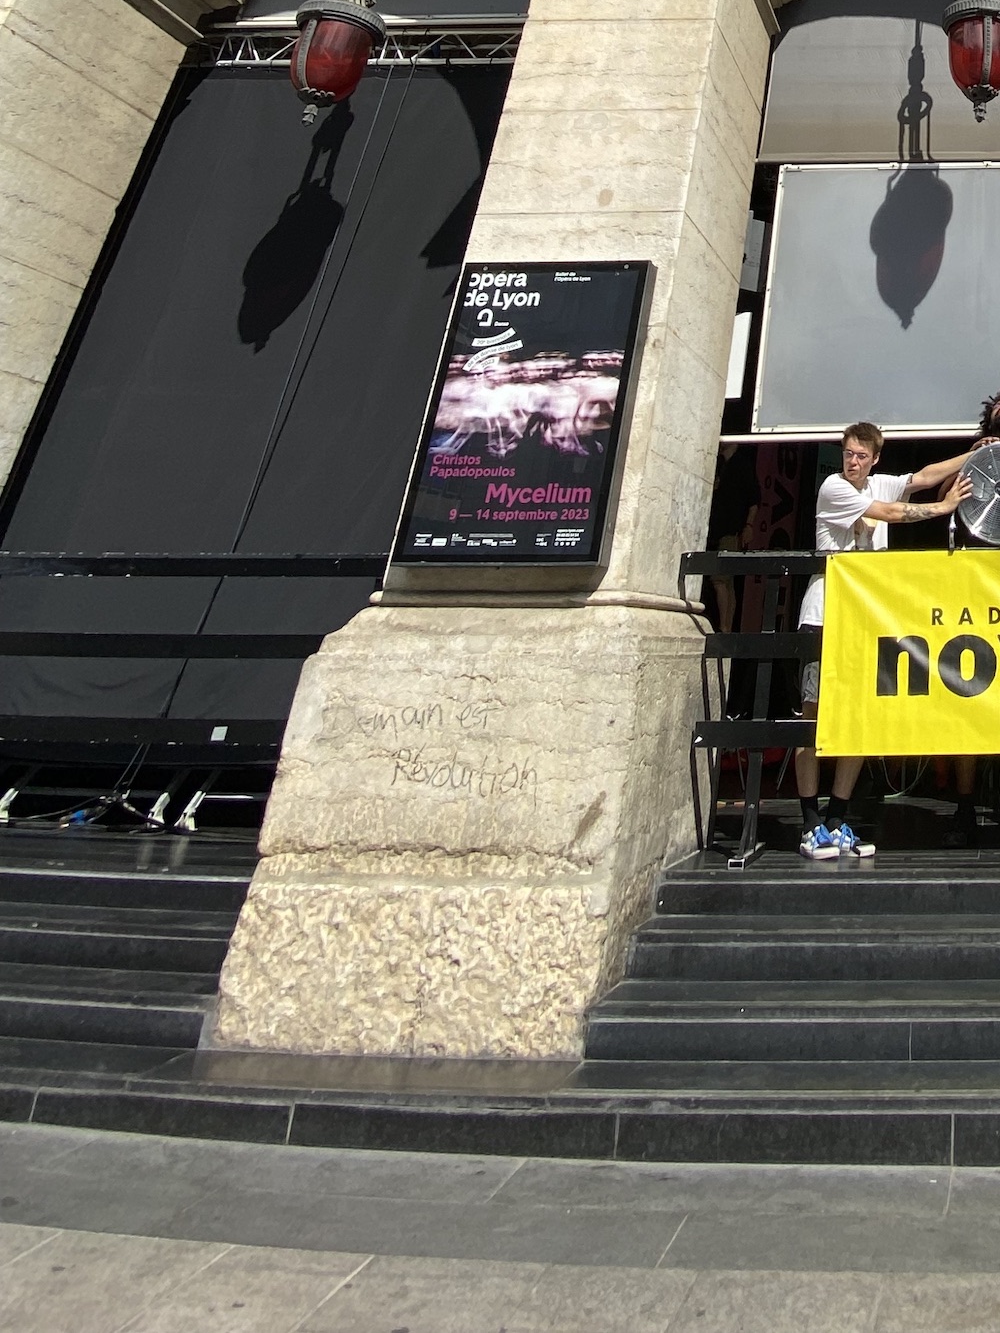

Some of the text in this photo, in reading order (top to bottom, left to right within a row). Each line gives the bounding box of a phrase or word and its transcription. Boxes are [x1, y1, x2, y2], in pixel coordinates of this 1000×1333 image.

[464, 289, 540, 310] de Lyon
[433, 454, 481, 465] Christos
[429, 466, 516, 479] Papadopoulos
[484, 483, 592, 508] Mycelium
[449, 508, 457, 520] 9
[476, 509, 490, 520] 14
[492, 509, 558, 522] septembre
[560, 508, 589, 520] 2023
